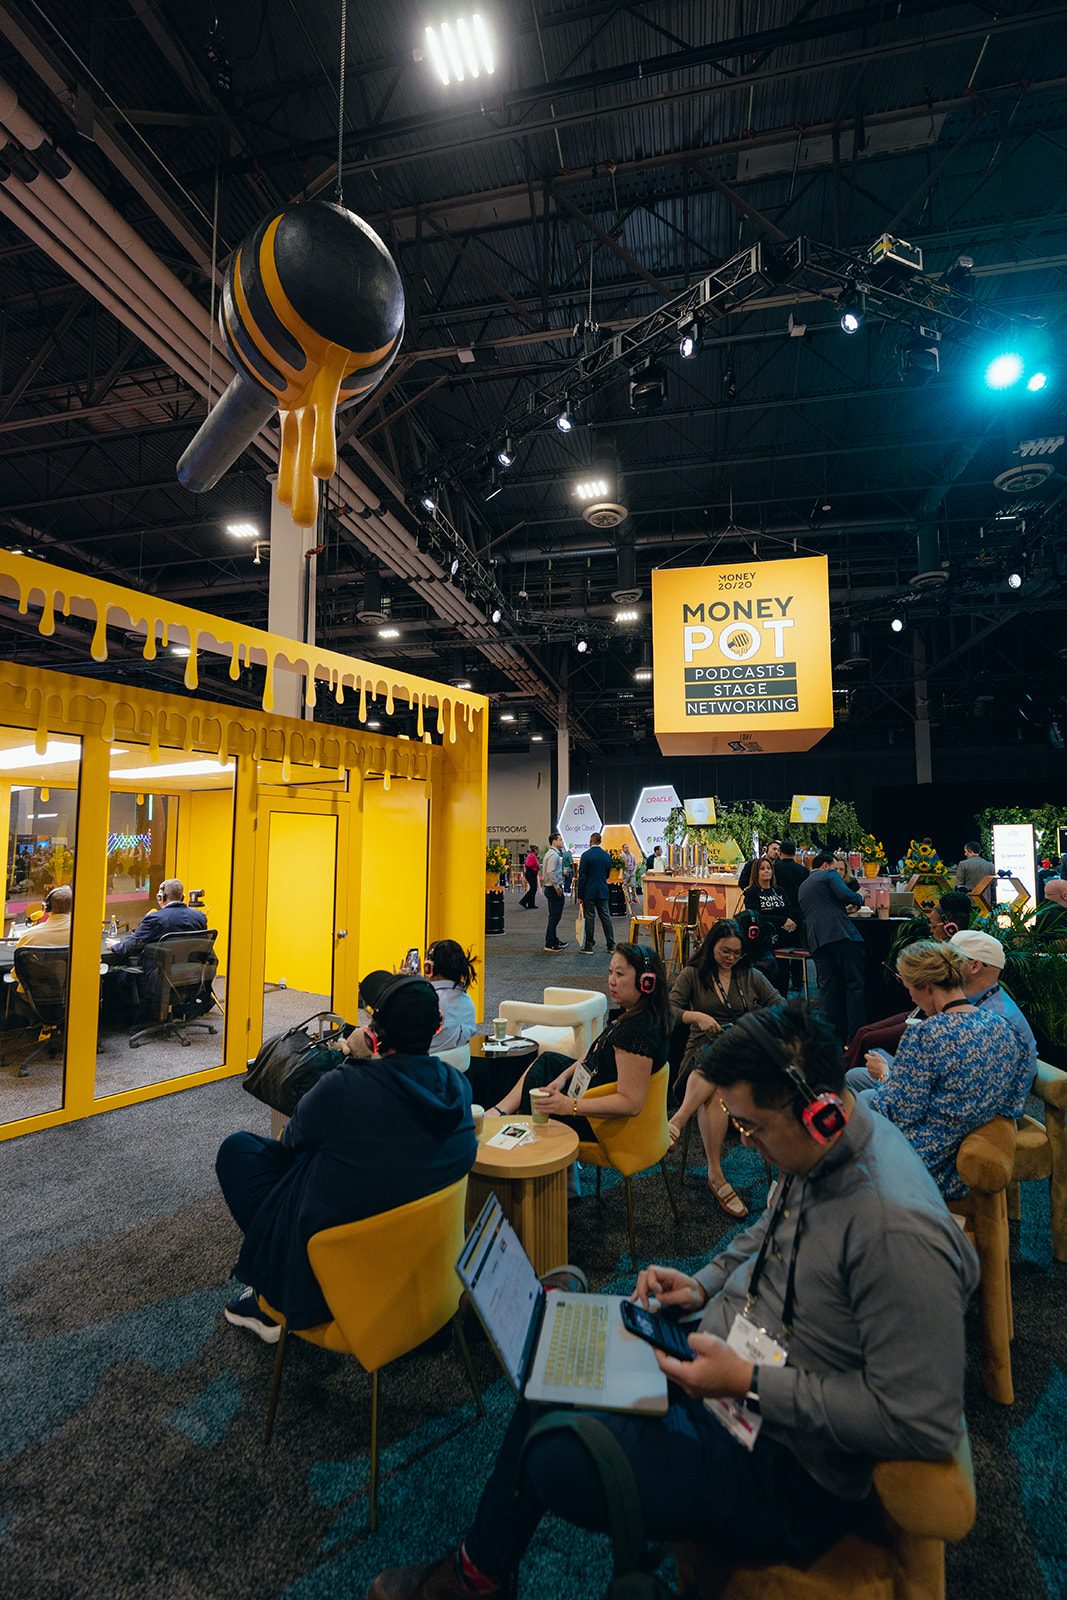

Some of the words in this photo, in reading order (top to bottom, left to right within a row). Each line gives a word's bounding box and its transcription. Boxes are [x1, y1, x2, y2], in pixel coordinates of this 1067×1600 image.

[718, 572, 757, 583] MONEY
[718, 581, 753, 591] 20/20
[682, 596, 794, 624] MONEY
[683, 619, 795, 663] POT
[695, 665, 785, 681] PODCASTS
[713, 683, 768, 697] STAGE
[687, 699, 797, 714] NETWORKING
[645, 795, 673, 804] ORACLE
[573, 805, 585, 816] citi
[565, 824, 581, 834] Google
[582, 823, 595, 832] Cloud
